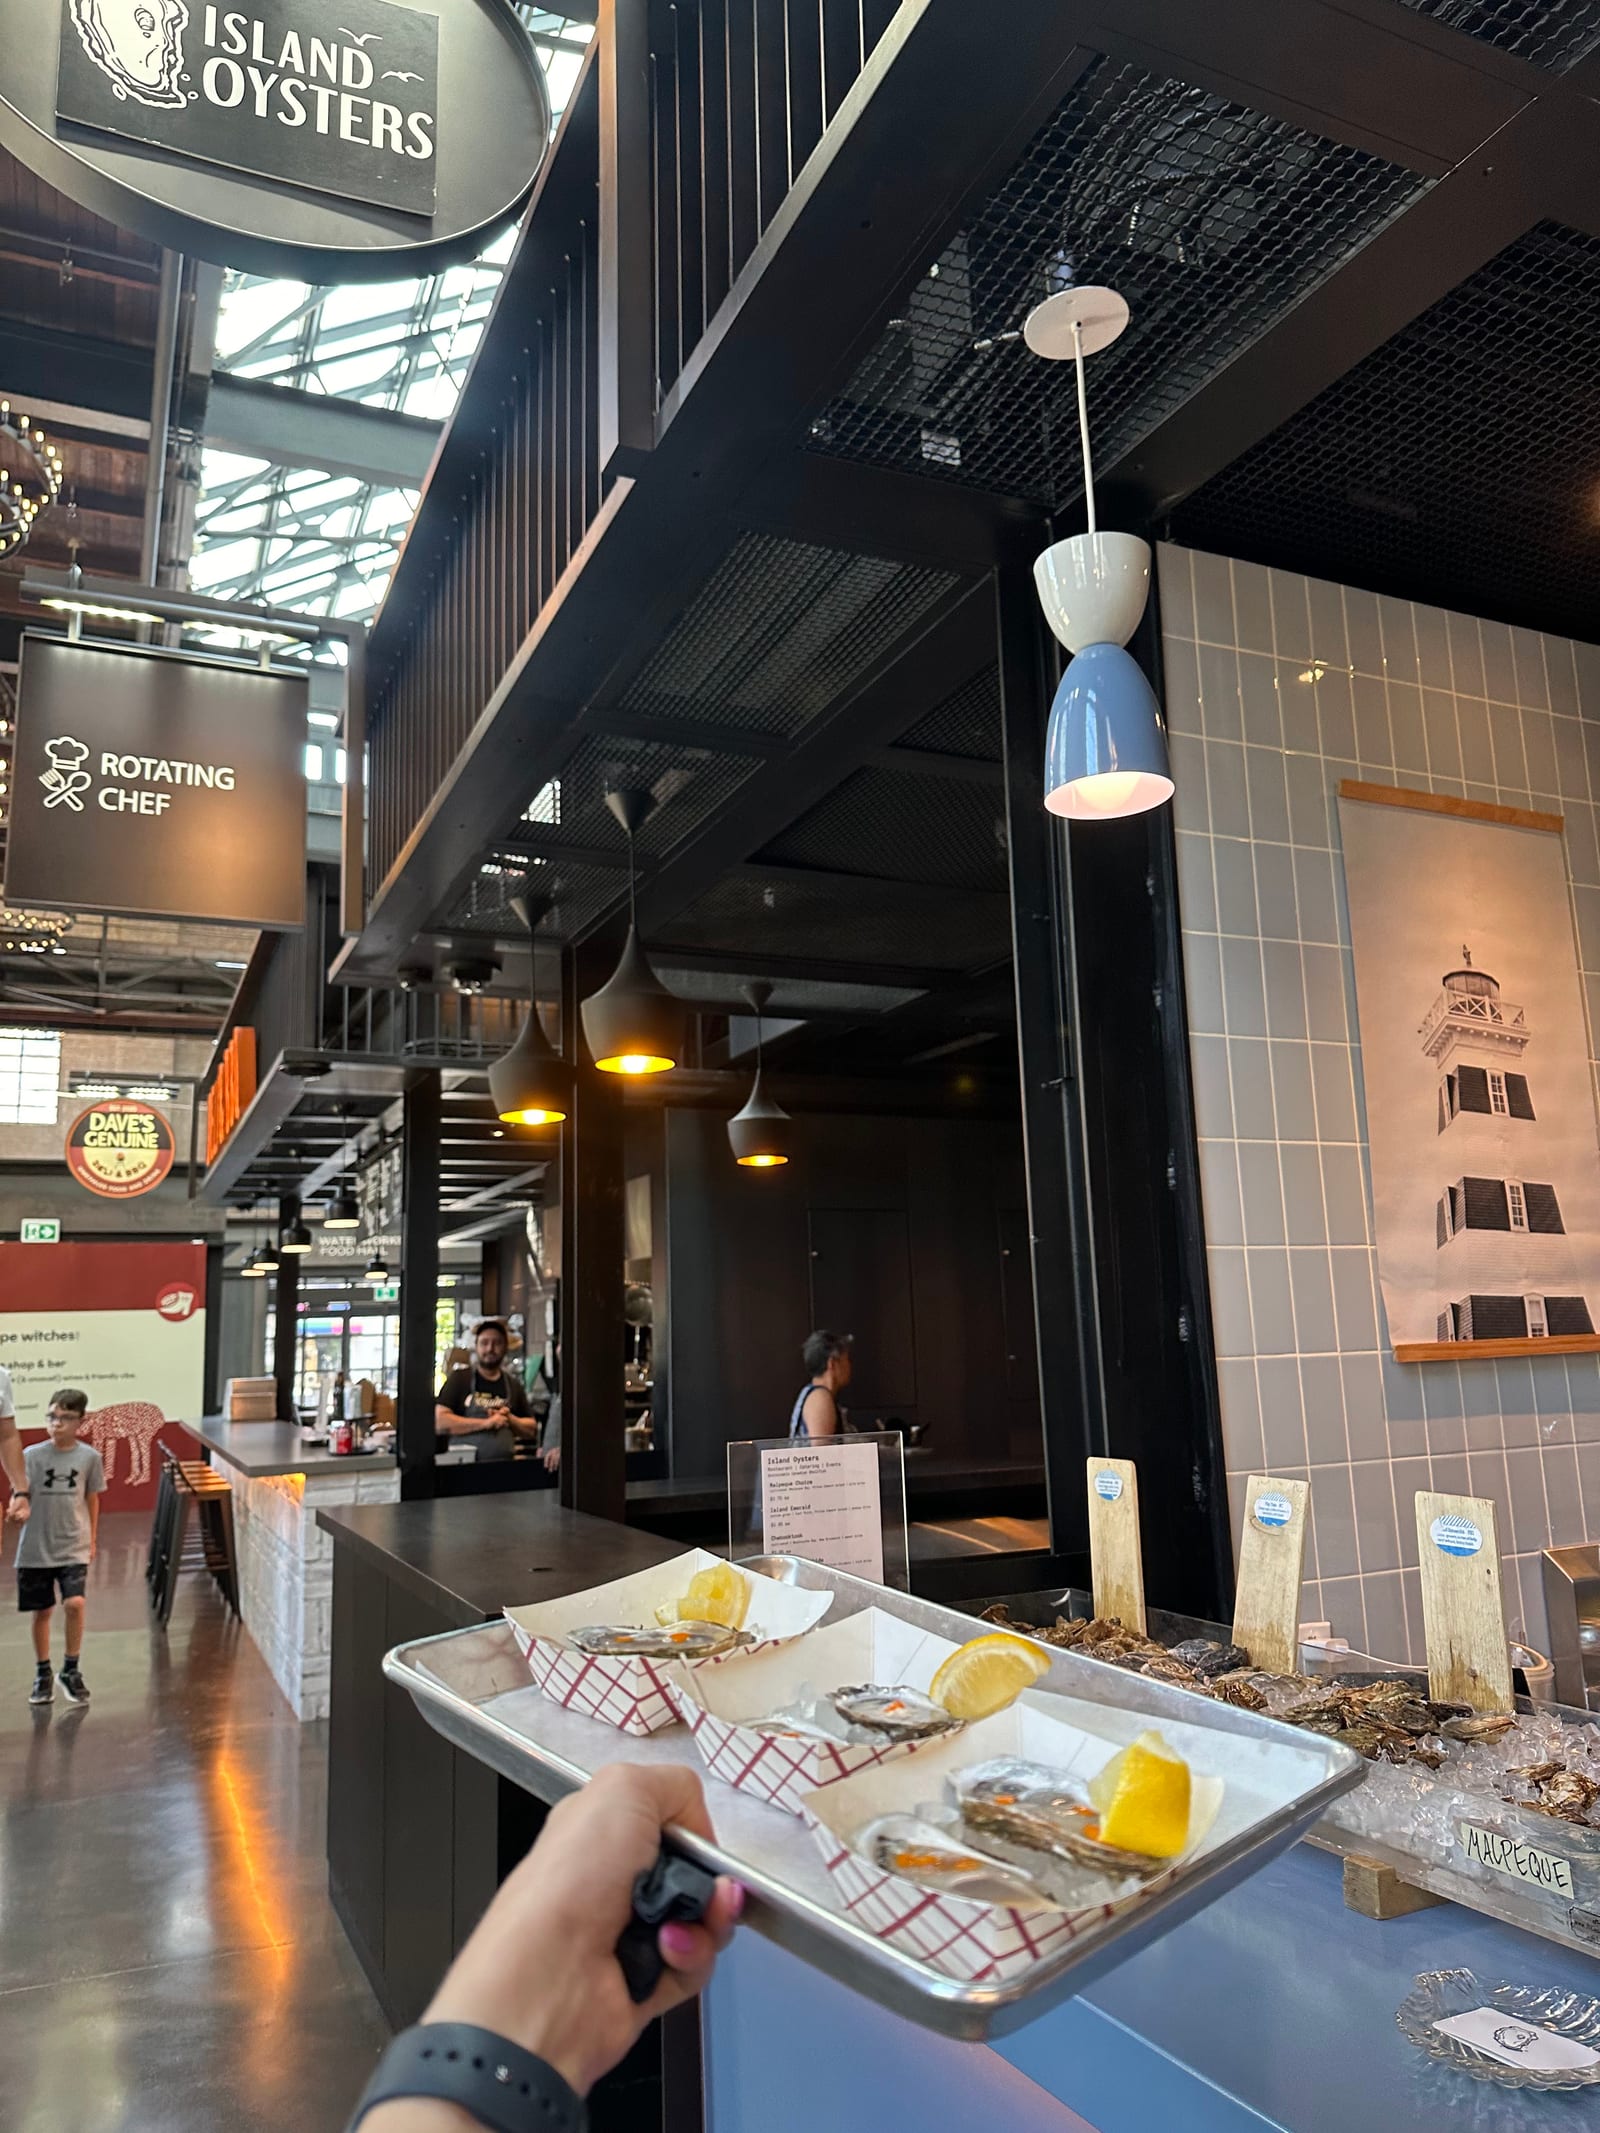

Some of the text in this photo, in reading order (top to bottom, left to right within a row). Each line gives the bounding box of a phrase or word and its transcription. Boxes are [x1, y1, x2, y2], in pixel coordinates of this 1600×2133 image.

[203, 5, 375, 91] ISLAND
[202, 56, 434, 160] OYSTERS
[101, 752, 236, 791] ROTATING
[98, 787, 171, 816] CHEF
[89, 1112, 156, 1133] DAVE'S
[84, 1131, 159, 1148] GENUINE
[320, 1246, 355, 1256] FOOD
[768, 1456, 819, 1465] Island Oysters
[770, 1506, 788, 1514] Island
[1468, 1828, 1569, 1887] MALPEQUE
